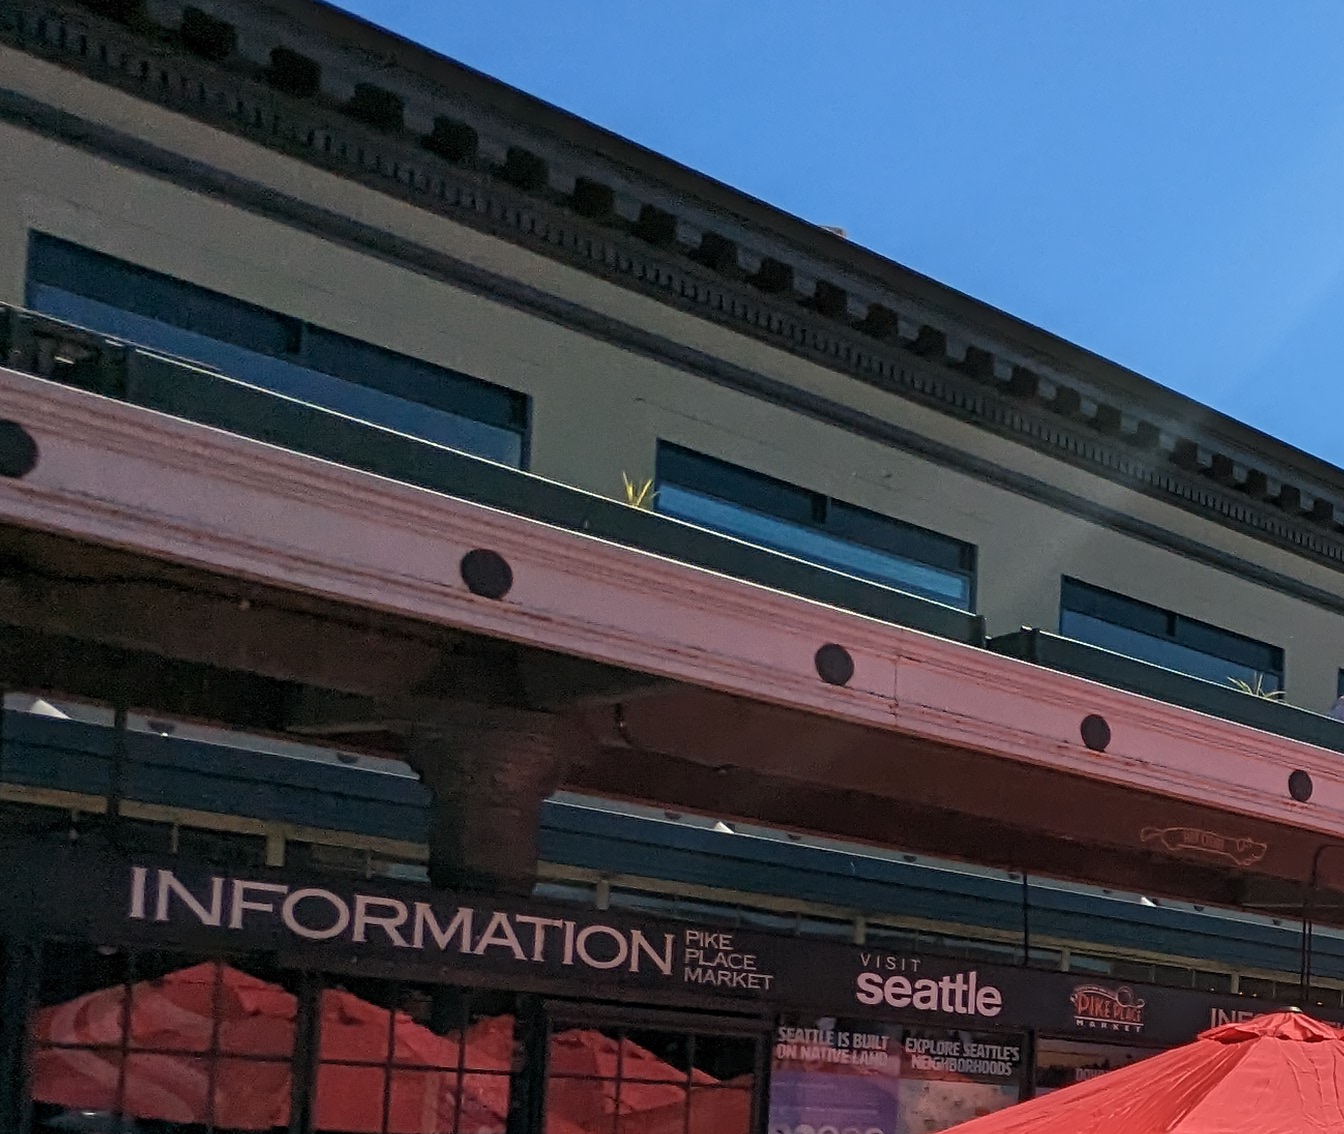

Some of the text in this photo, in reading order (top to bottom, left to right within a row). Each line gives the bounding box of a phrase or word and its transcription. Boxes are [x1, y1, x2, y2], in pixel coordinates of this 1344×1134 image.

[129, 866, 675, 975] INFORMATION
[684, 930, 734, 951] PIKE
[684, 948, 757, 970] PLACE
[861, 952, 921, 971] VISIT
[684, 966, 774, 991] MARKET
[856, 971, 1002, 1017] seattle
[1078, 992, 1111, 1018] PIKE
[777, 1026, 889, 1050] SEATTLE IS BUILT
[1076, 1020, 1141, 1033] MARKET
[776, 1044, 888, 1067] ON NATIVE LAND
[905, 1037, 1020, 1062] EXPLORE SEATTLE'S
[911, 1054, 1013, 1076] NEIGHBORHOODS
